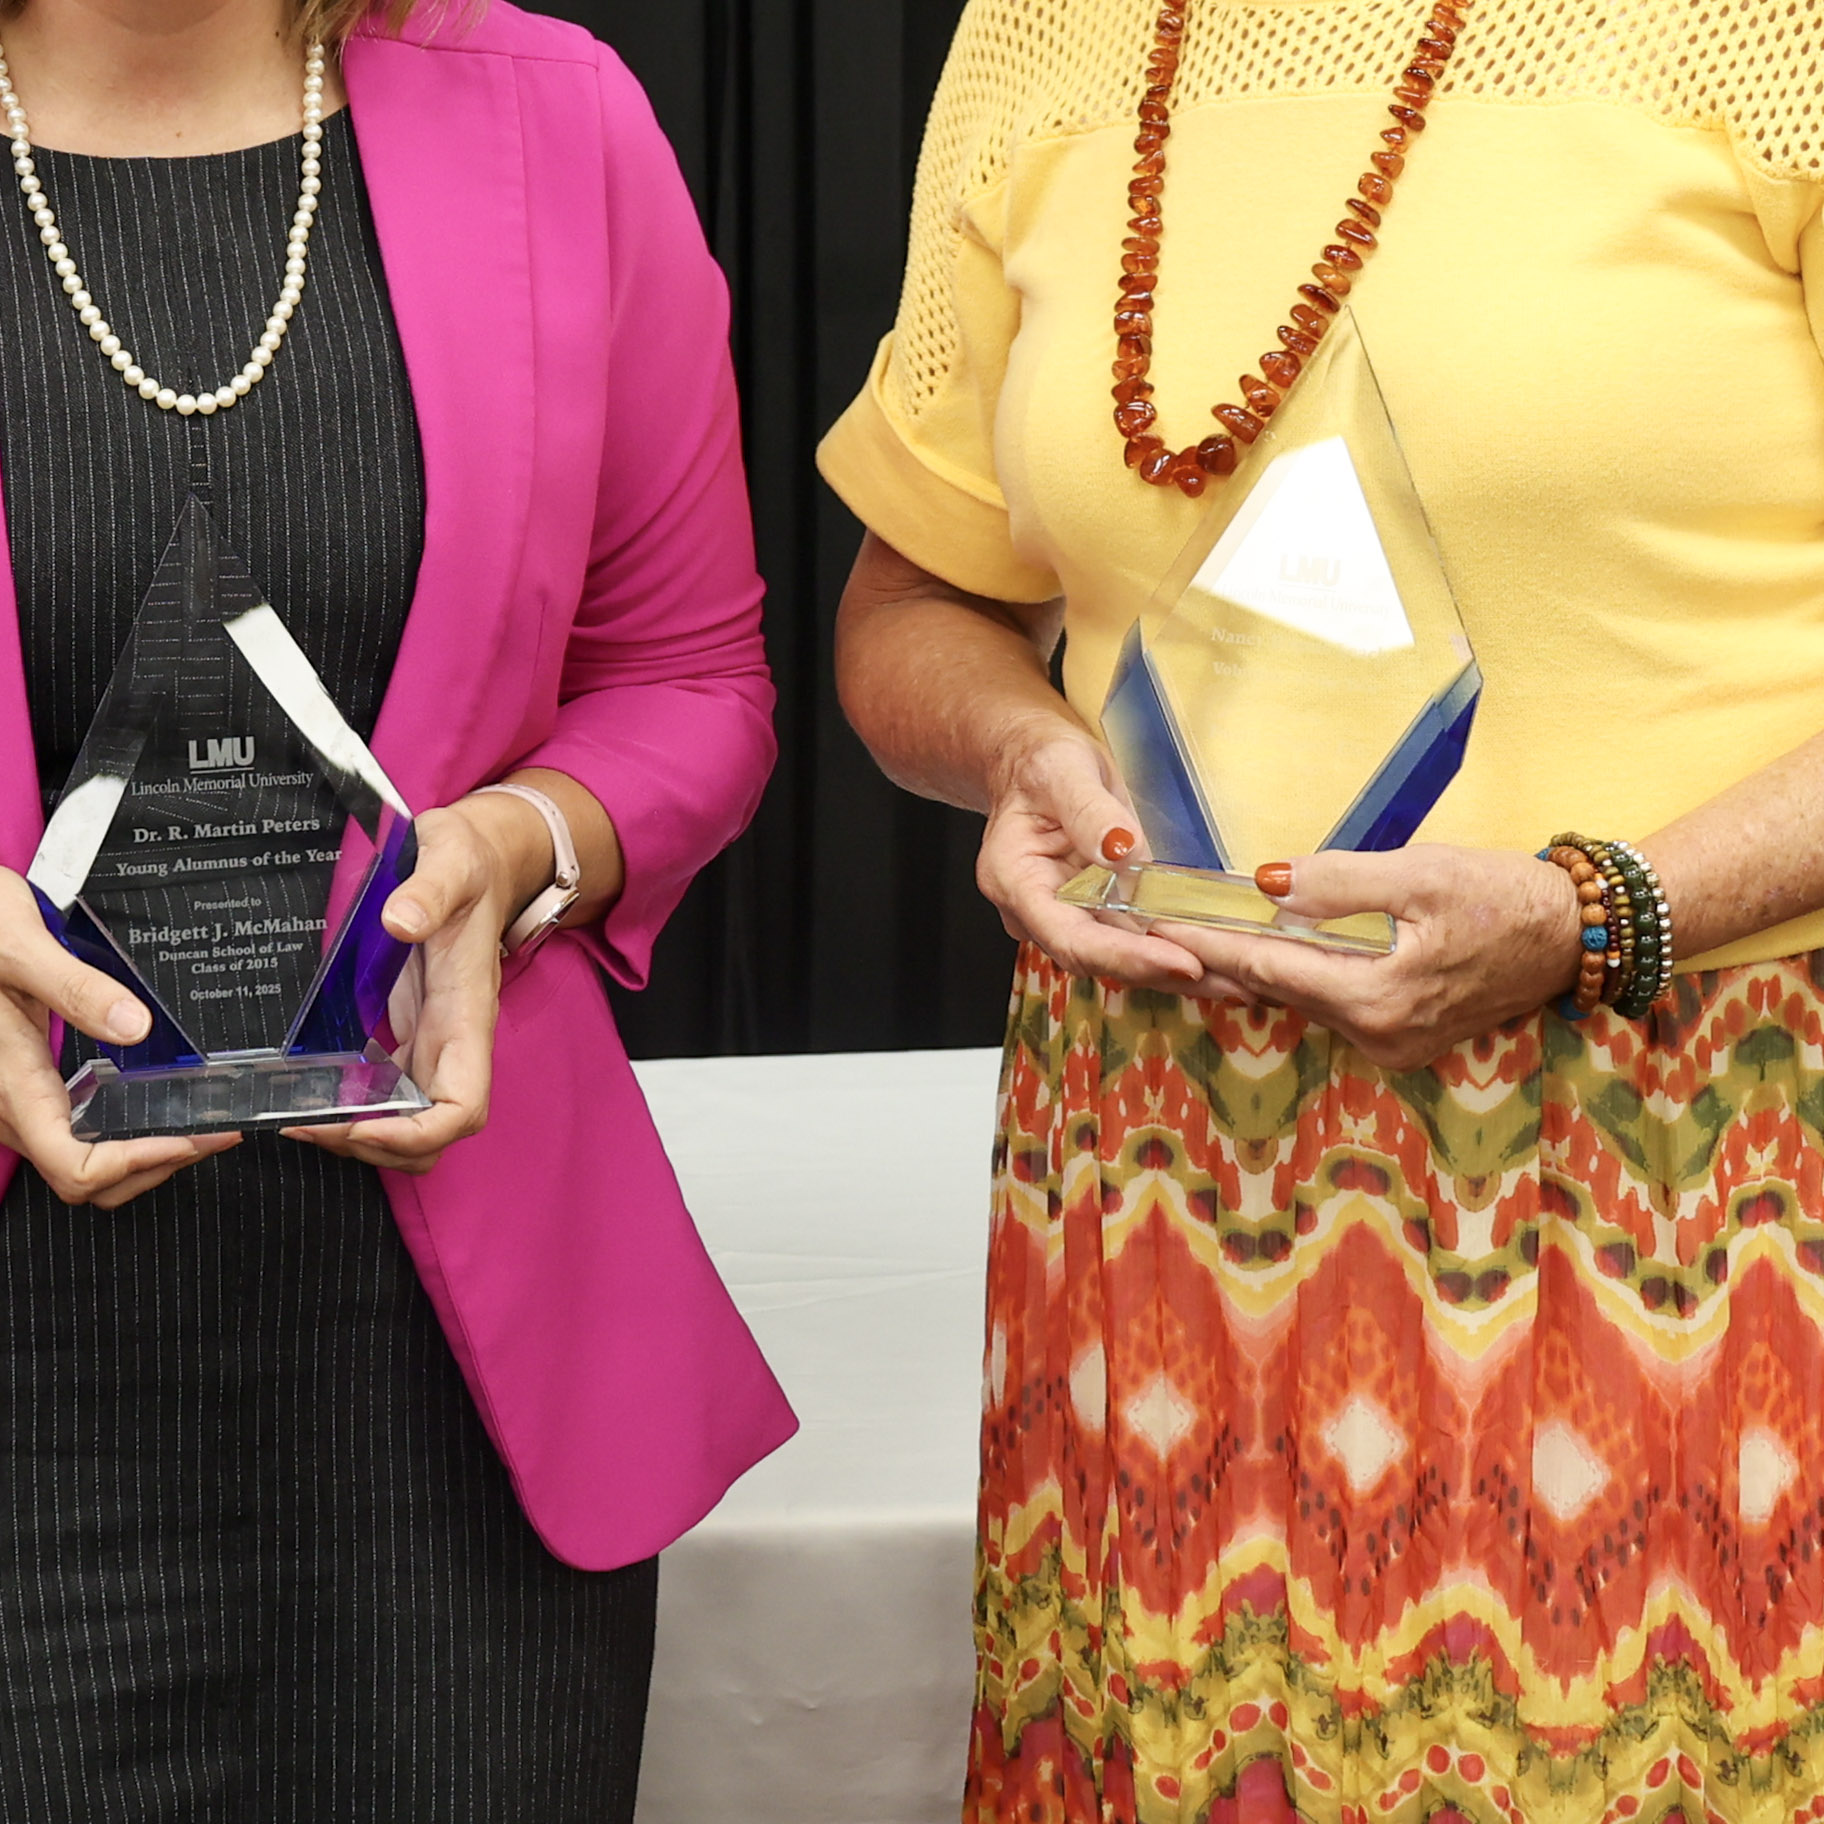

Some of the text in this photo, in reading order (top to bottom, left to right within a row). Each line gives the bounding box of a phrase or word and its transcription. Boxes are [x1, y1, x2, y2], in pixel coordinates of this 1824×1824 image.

[1279, 553, 1340, 587] LMU
[188, 736, 256, 769] LMU
[132, 771, 314, 796] Lincoln Memorial University
[133, 818, 321, 844] Dr. R. Martin Peters
[116, 848, 343, 877] Young Alumnus of the Year
[194, 897, 262, 911] Presented to
[128, 916, 329, 946] Bridgett J. McMahan
[159, 941, 304, 962] Duncan School of Law
[191, 957, 278, 975] Class of 2015
[190, 983, 281, 1001] October 11, 2025
